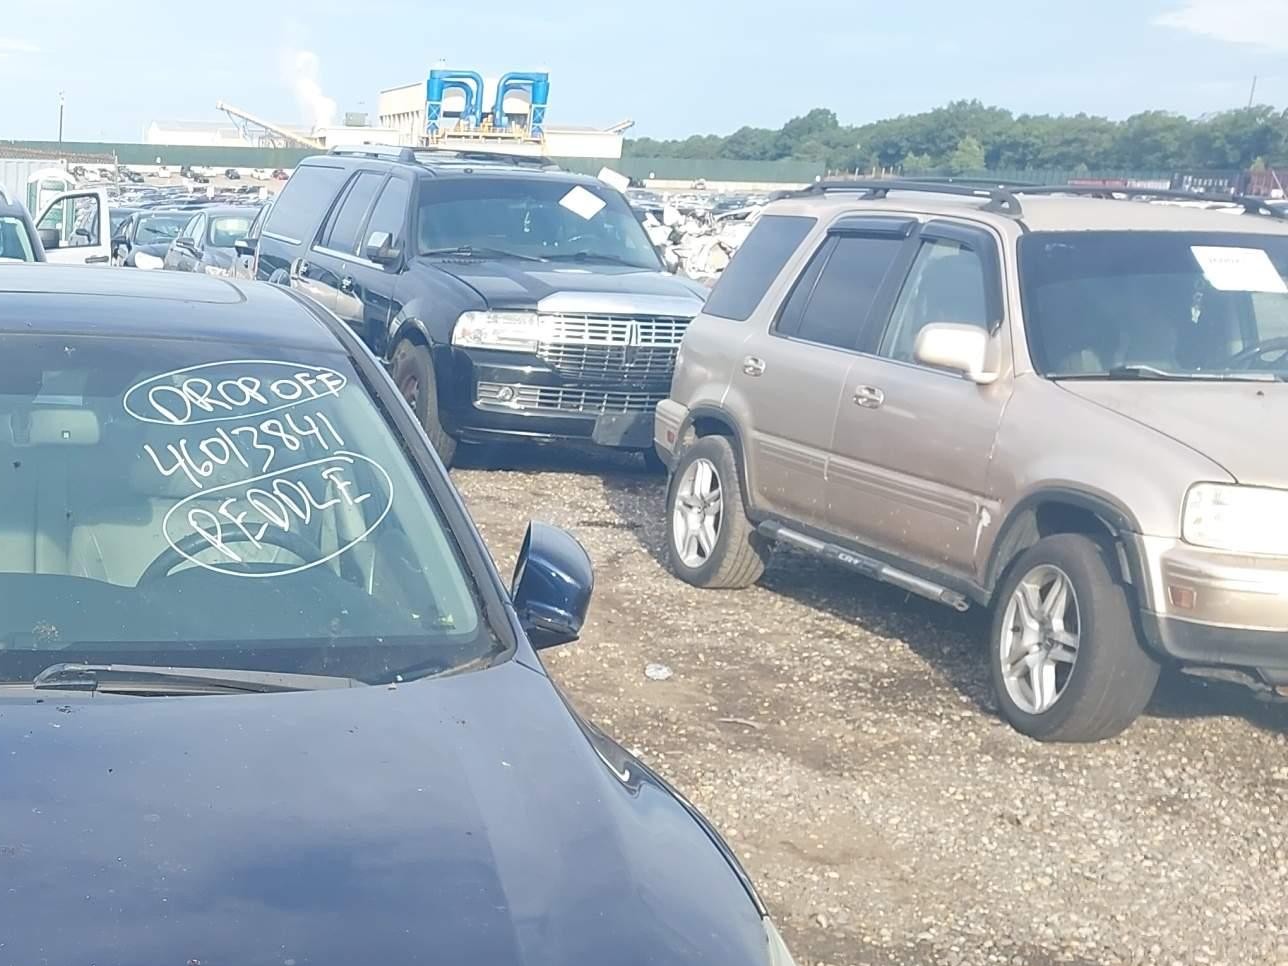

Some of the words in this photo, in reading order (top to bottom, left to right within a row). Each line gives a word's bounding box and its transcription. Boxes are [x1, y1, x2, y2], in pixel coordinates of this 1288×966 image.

[148, 377, 268, 424] DROP
[270, 372, 344, 399] OFF
[143, 412, 345, 489] 46013841
